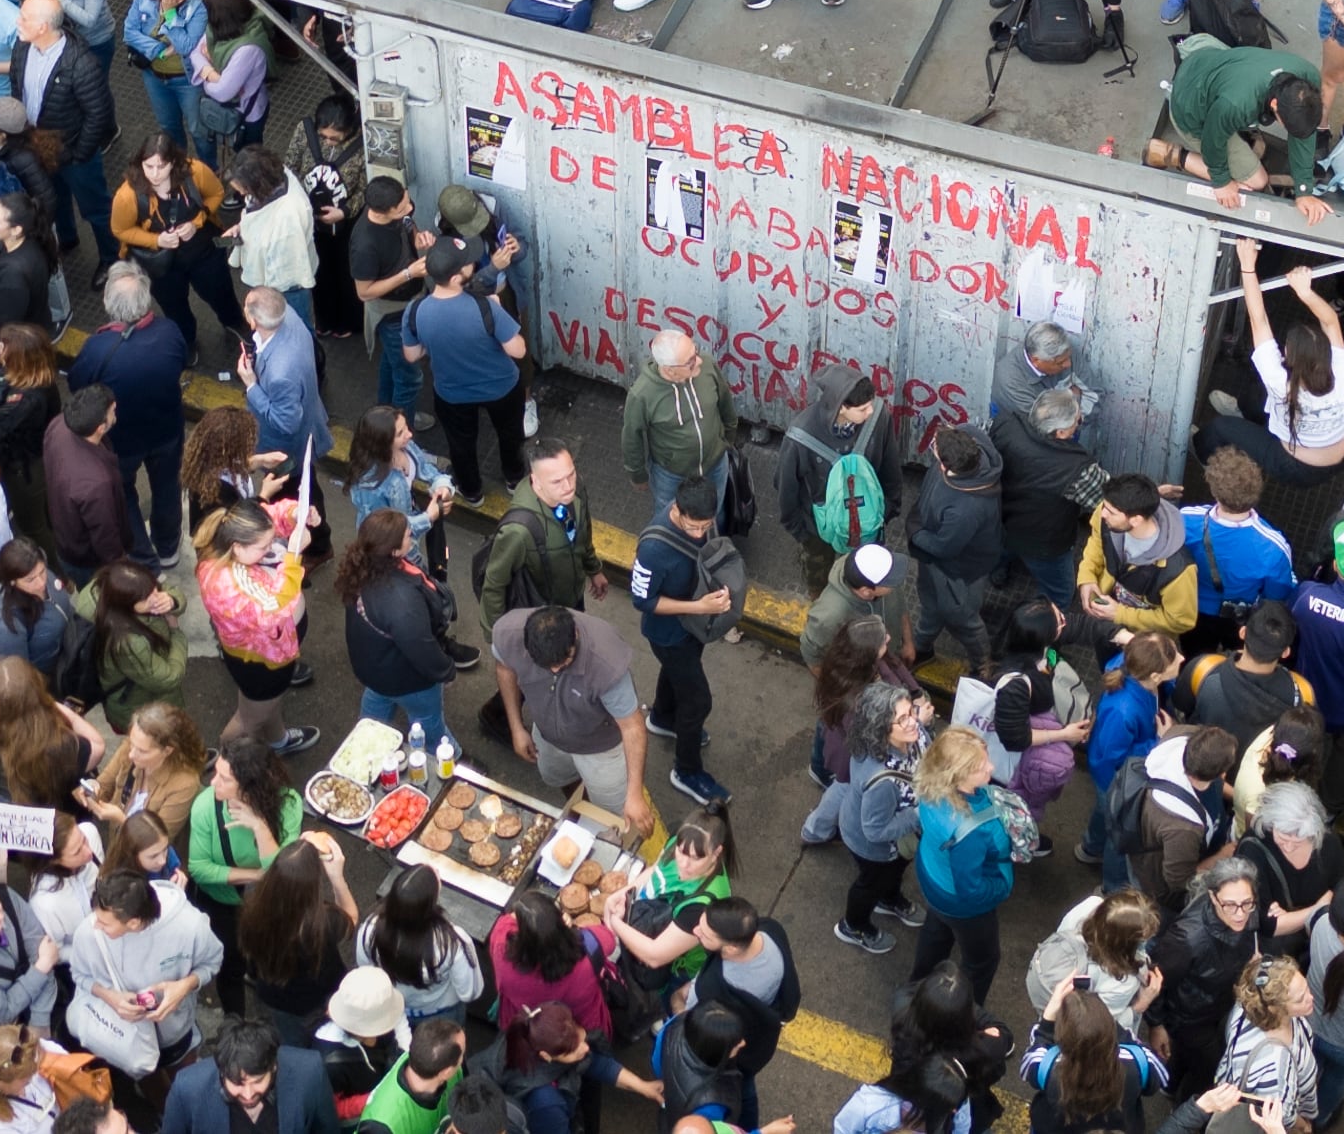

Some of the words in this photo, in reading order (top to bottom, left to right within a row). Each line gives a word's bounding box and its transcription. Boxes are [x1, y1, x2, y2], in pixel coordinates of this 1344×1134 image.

[493, 61, 787, 178] ASAMBLEA
[822, 141, 1102, 276] NACIONAL
[550, 146, 618, 192] DE
[706, 183, 1010, 312] RABADOR
[641, 227, 897, 329] OCUPADOS
[549, 310, 624, 374] VIA
[604, 287, 969, 426] DESOCUDOS
[759, 293, 786, 331] Y
